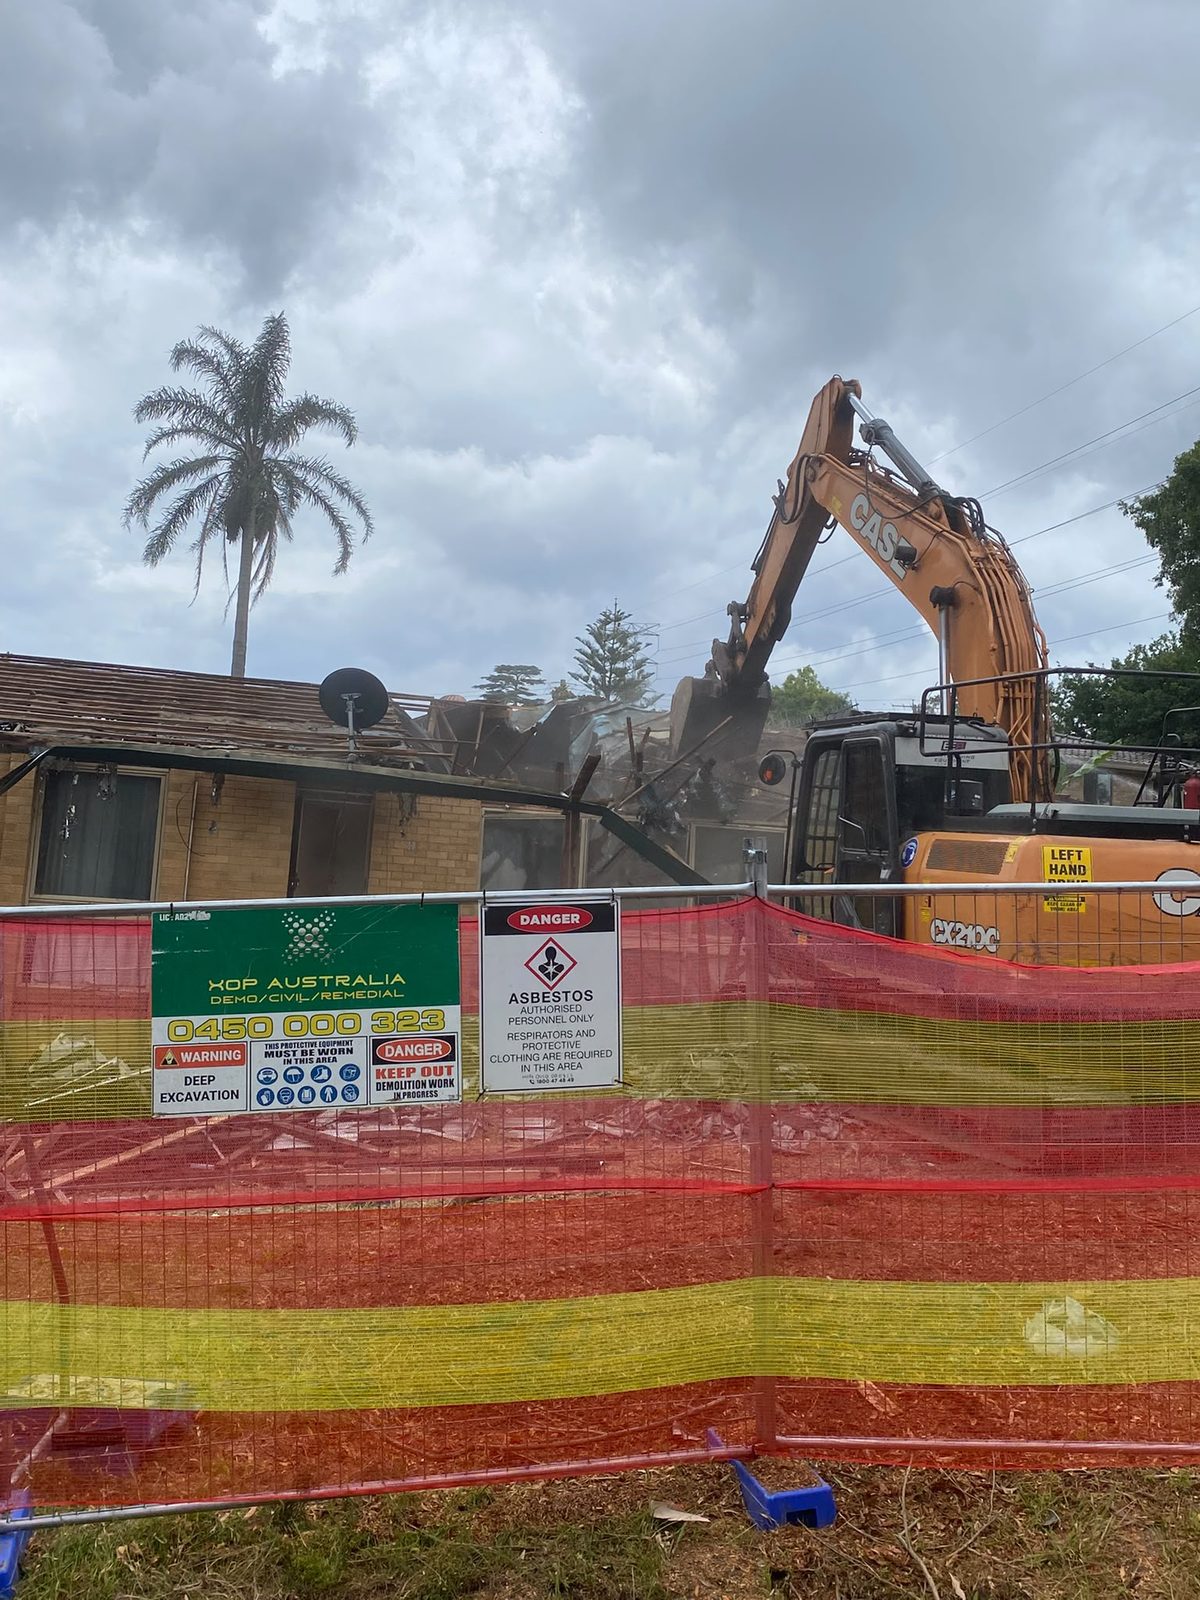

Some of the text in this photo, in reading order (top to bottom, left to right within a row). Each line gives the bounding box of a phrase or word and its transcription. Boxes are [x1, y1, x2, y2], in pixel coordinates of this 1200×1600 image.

[1051, 849, 1083, 861] LEFT
[1049, 864, 1086, 875] HAND
[520, 913, 580, 926] DANGER
[931, 918, 1000, 953] CX210C
[209, 973, 406, 992] XOP AUSTRALIA
[210, 989, 405, 1005] DEMO/CIVIL/REMEDIAL
[509, 990, 594, 1004] ASBESTOS
[520, 1004, 582, 1015] AUTHORISED
[168, 1009, 446, 1042] 0450 000 323
[509, 1014, 594, 1026] PERSONNEL ONLY
[507, 1029, 596, 1041] RESPIRATORS AND
[265, 1040, 353, 1050] THIS PROTECTIVE EQUIPMENT
[385, 1043, 443, 1057] DANGER
[522, 1041, 581, 1051] PROTECTIVE
[181, 1050, 242, 1063] WARNING
[264, 1047, 353, 1058] MUST BE WORN
[490, 1050, 613, 1064] CLOTHING ARE REQUIRED
[294, 1057, 314, 1065] THIS
[376, 1065, 454, 1080] KEEP OUT
[521, 1062, 583, 1073] IN THIS AREA
[184, 1075, 215, 1086] DEEP
[376, 1078, 455, 1091] DEMOLITION WORK
[160, 1089, 240, 1103] EXCAVATION
[394, 1090, 438, 1100] IN PROGRESS
